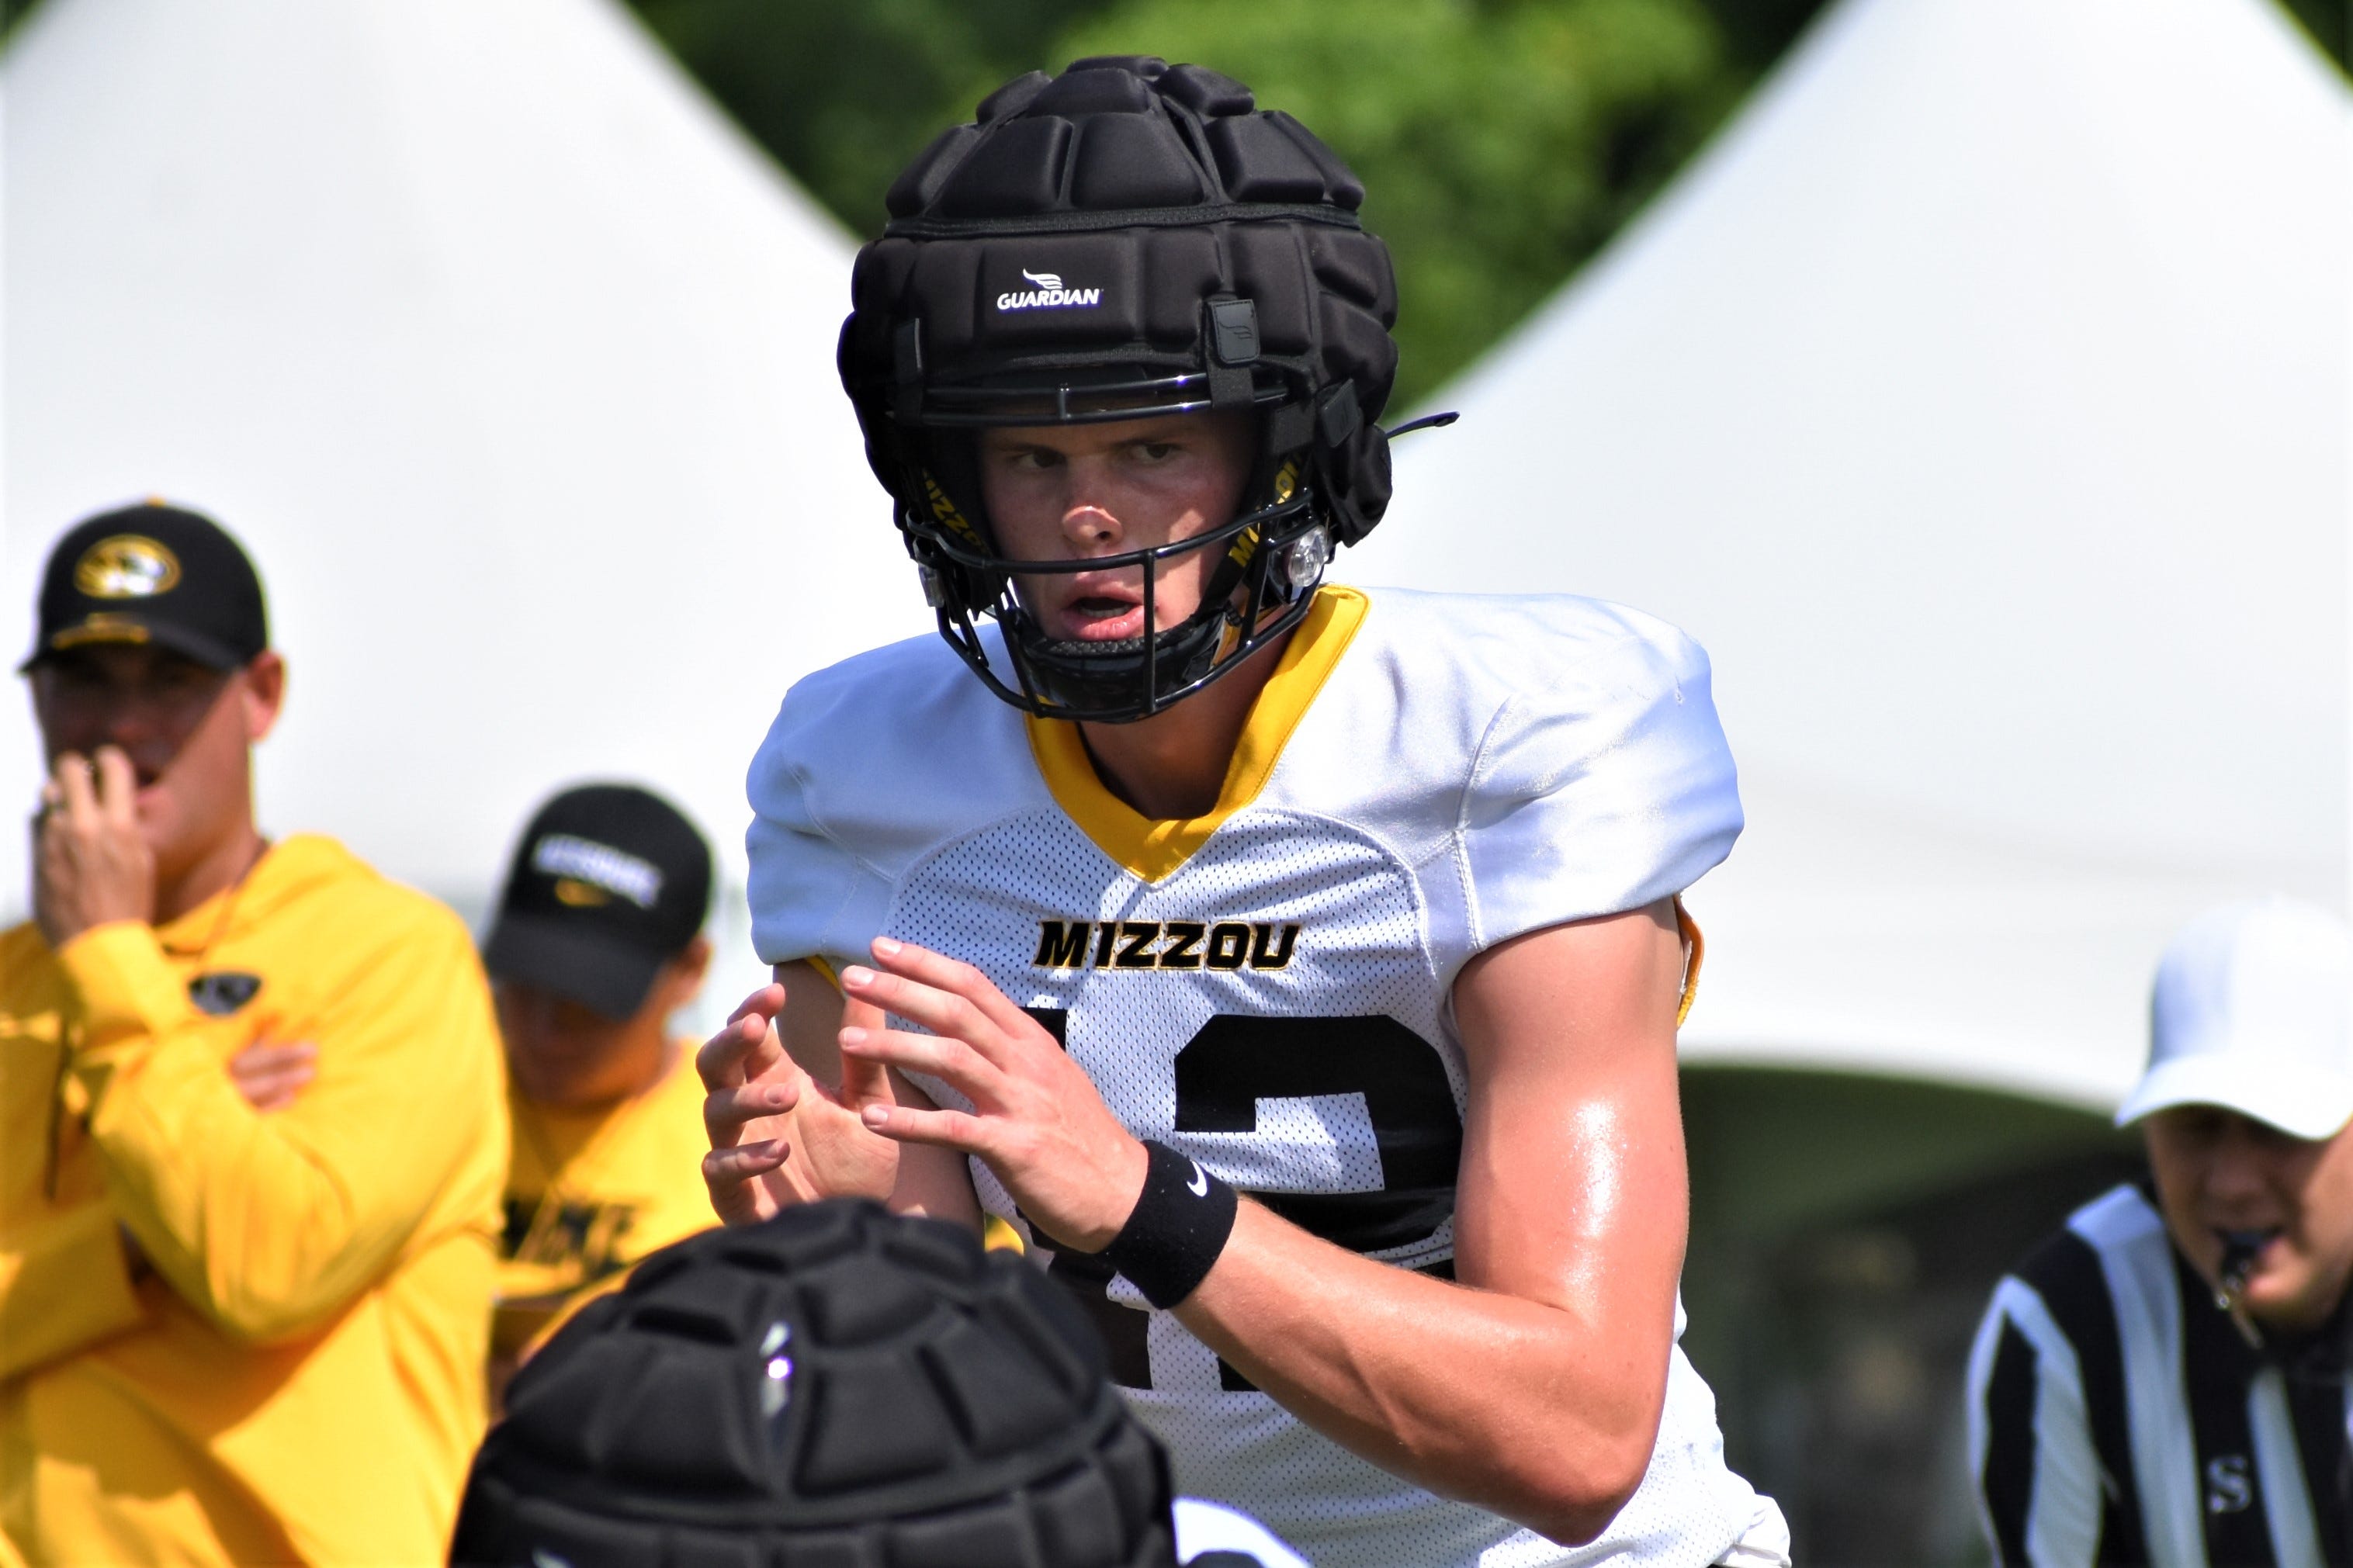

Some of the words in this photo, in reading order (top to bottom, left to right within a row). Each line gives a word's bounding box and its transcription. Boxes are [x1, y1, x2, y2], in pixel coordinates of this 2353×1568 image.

[996, 288, 1100, 310] GUARDIAN
[1031, 919, 1301, 971] MIZZOU
[2208, 1456, 2251, 1513] S
